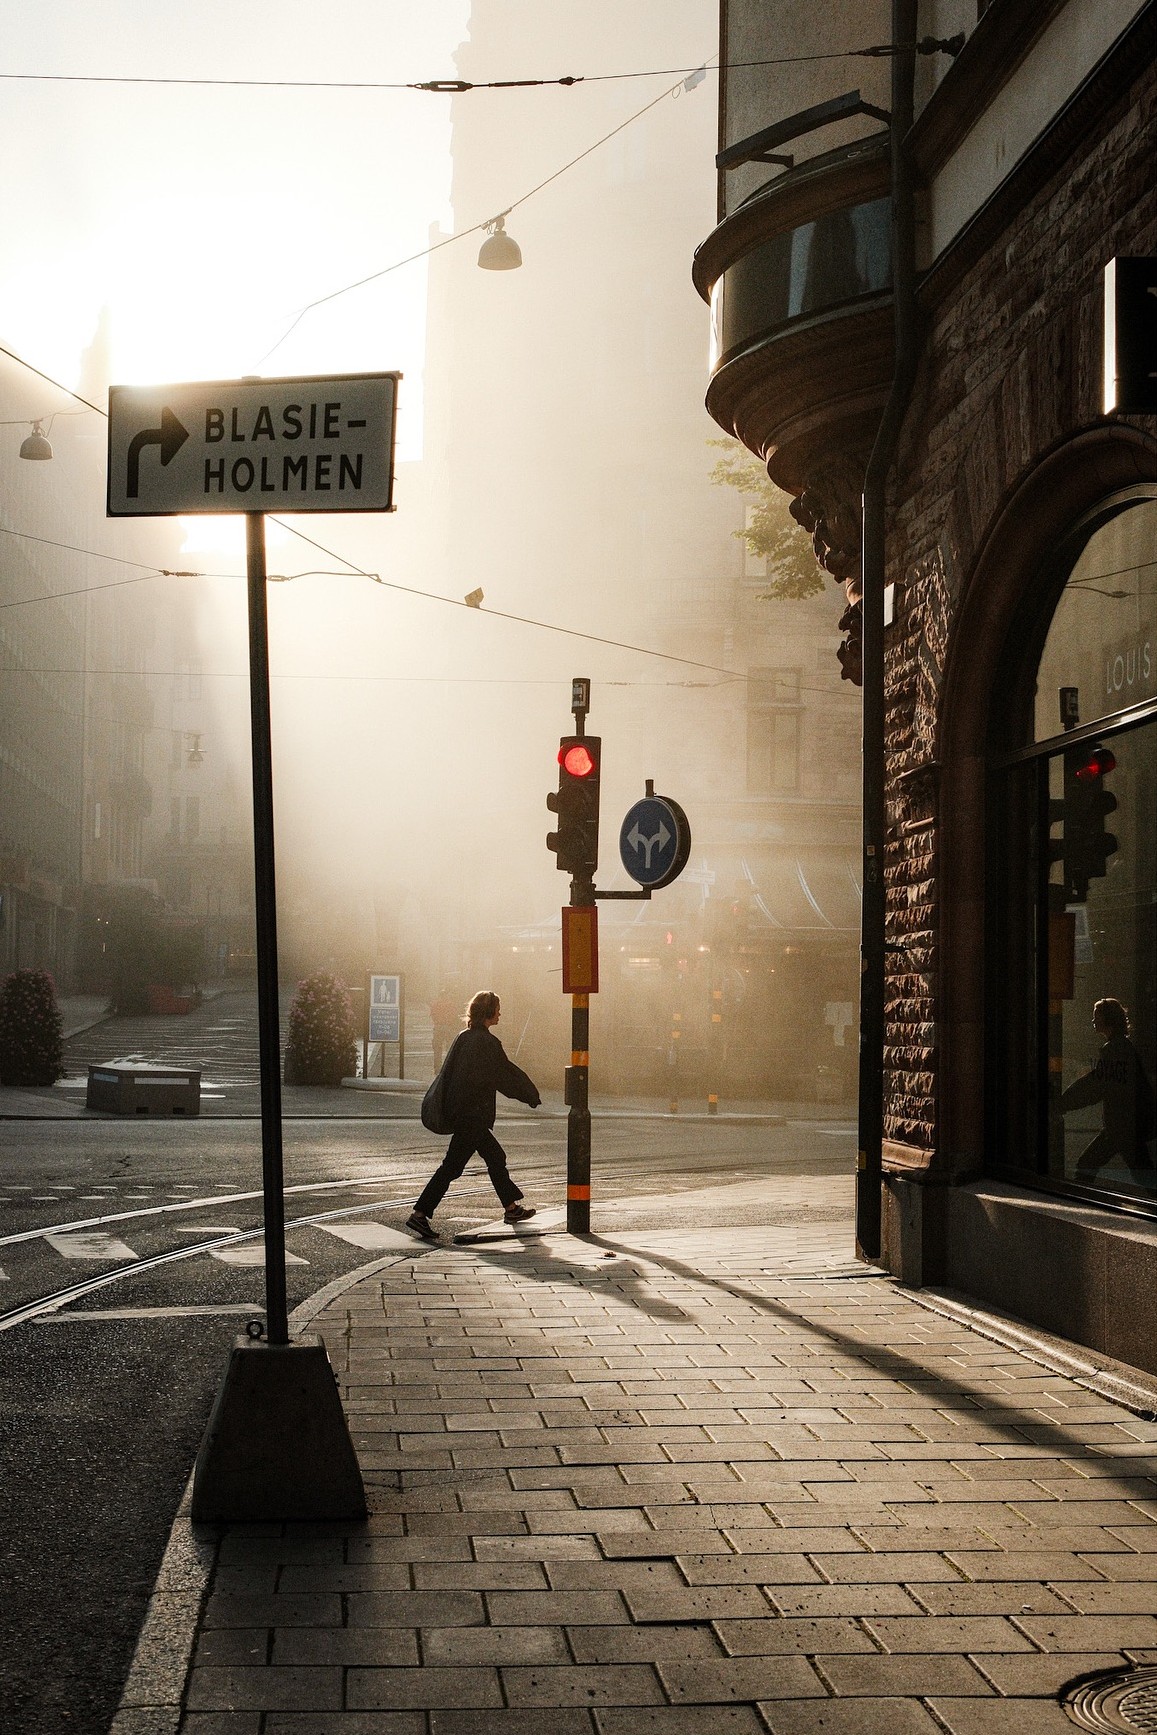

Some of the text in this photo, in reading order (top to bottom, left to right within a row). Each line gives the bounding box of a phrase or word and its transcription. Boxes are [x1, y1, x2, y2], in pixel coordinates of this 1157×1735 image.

[205, 403, 367, 443] BLASIE-
[204, 453, 363, 493] HOLMEN
[1106, 642, 1151, 695] LOUIS
